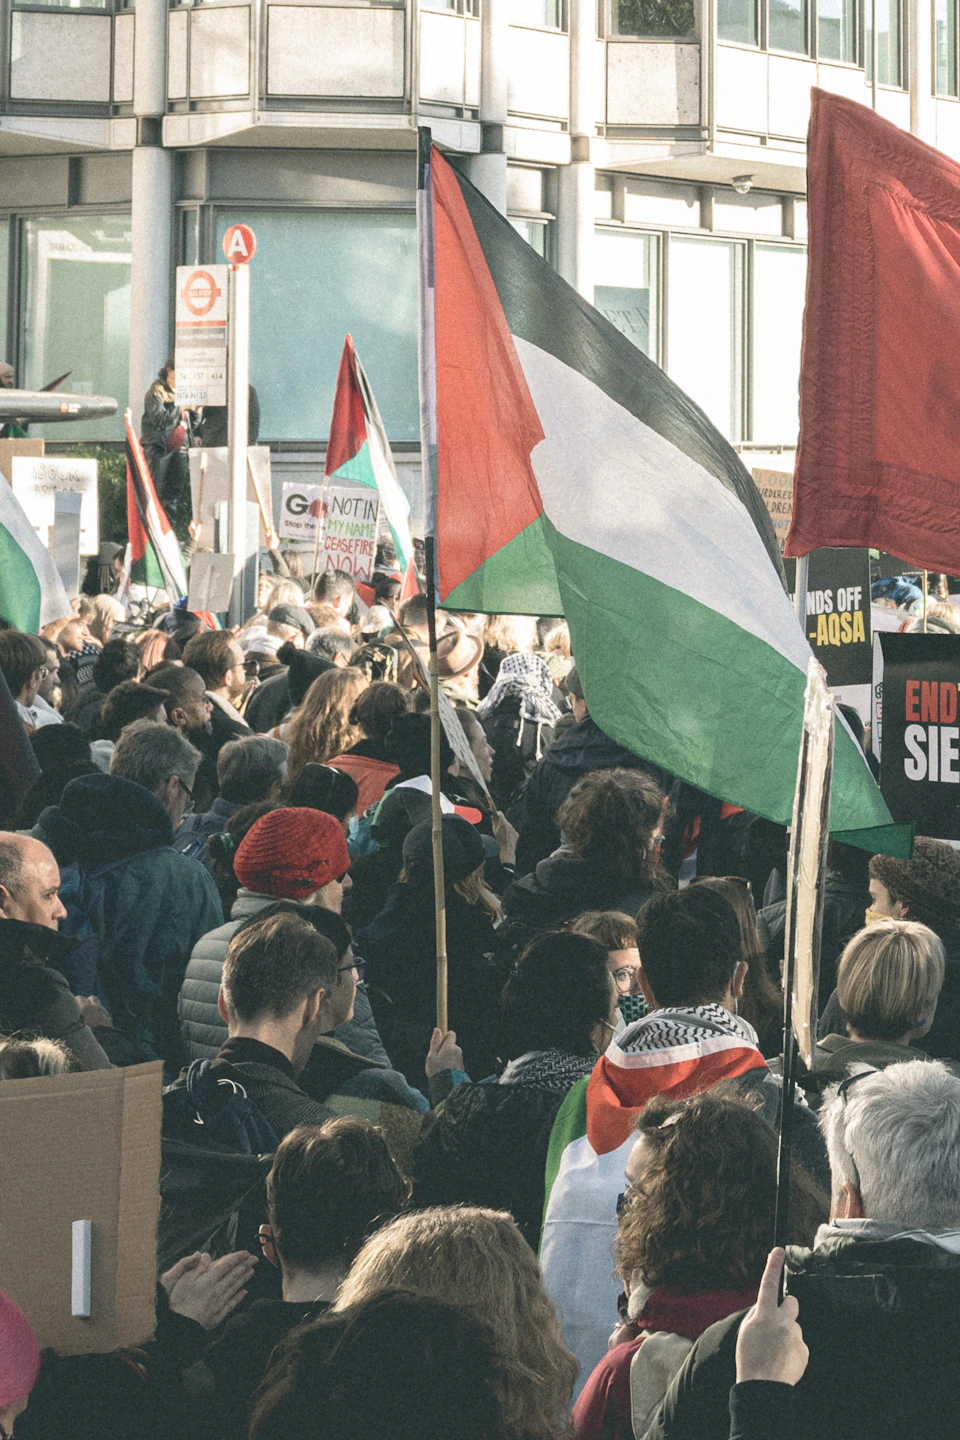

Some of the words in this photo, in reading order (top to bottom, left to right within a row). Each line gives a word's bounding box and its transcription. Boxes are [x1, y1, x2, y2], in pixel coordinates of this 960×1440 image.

[228, 229, 248, 257] A
[332, 495, 364, 518] NOT
[363, 499, 379, 522] IN
[284, 520, 302, 529] Stop
[327, 518, 344, 534] MY
[345, 520, 377, 539] NAME
[324, 535, 375, 557] CEASEFIRE
[325, 553, 373, 580] NOW
[836, 586, 862, 612] OFF
